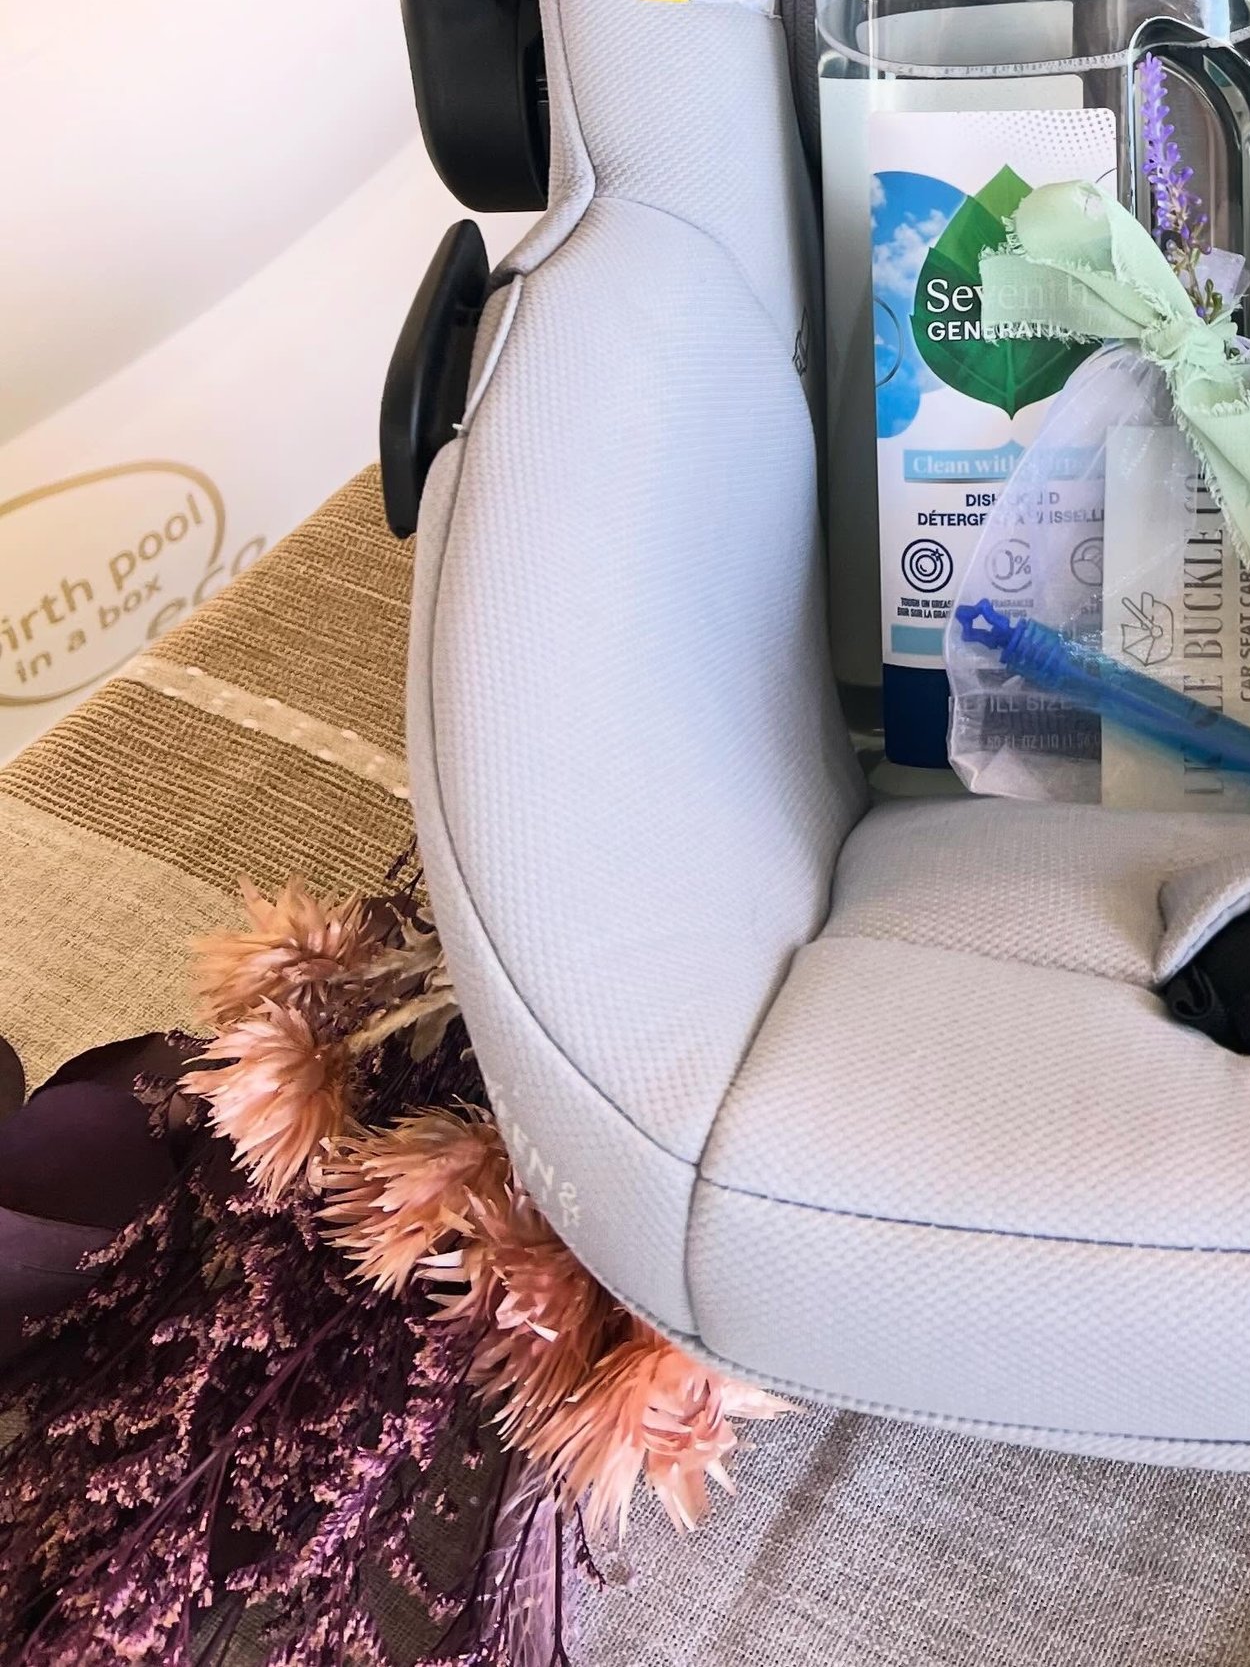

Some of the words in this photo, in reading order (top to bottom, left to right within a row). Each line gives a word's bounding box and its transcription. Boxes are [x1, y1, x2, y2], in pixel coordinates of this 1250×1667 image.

[912, 455, 970, 474] Clean
[0, 577, 94, 651] irth
[109, 492, 203, 592] pool
[17, 651, 52, 684] in
[67, 629, 87, 653] a
[98, 574, 163, 630] box
[1182, 529, 1224, 660] BUCKLE
